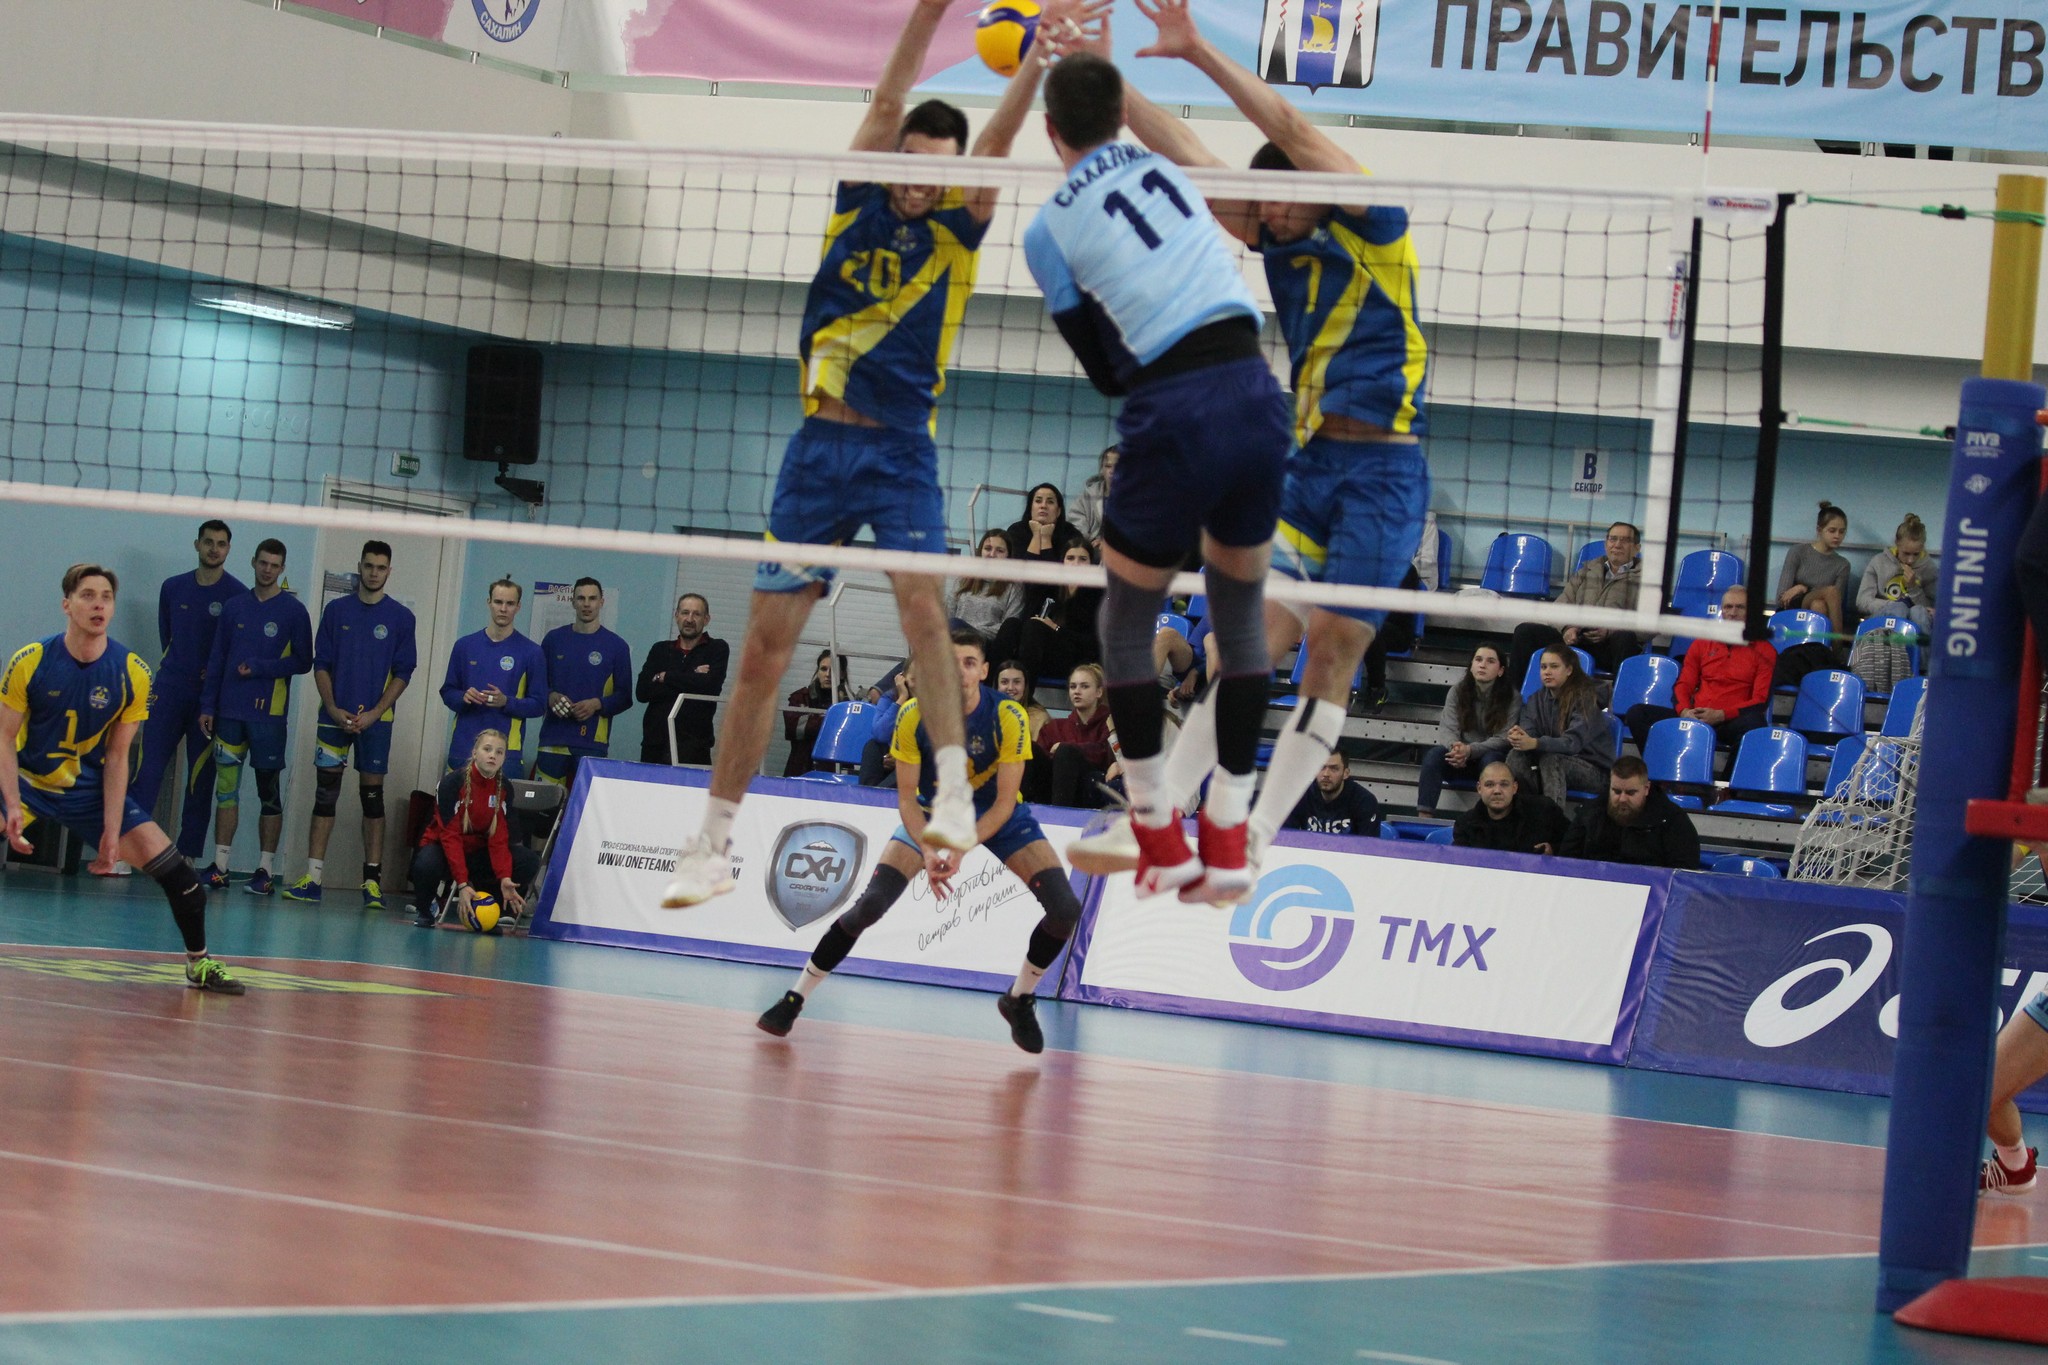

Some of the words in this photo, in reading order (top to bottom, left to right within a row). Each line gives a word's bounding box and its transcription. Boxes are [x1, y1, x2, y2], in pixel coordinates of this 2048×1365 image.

[480, 11, 523, 40] САХАЛИН
[1430, 0, 2046, 98] ПРАВИТЕЛЬСТВ
[1103, 168, 1195, 250] 11
[839, 247, 902, 300] 20
[1290, 254, 1323, 315] 7
[1583, 452, 1598, 480] В
[1574, 482, 1603, 493] СЕКТОР
[1947, 517, 1989, 657] JINLING
[57, 709, 79, 751] 1
[579, 725, 587, 736] 8
[600, 840, 660, 855] ПРОФЕССИОНАЛЬНЫЙ
[789, 882, 829, 894] САХАЛИН
